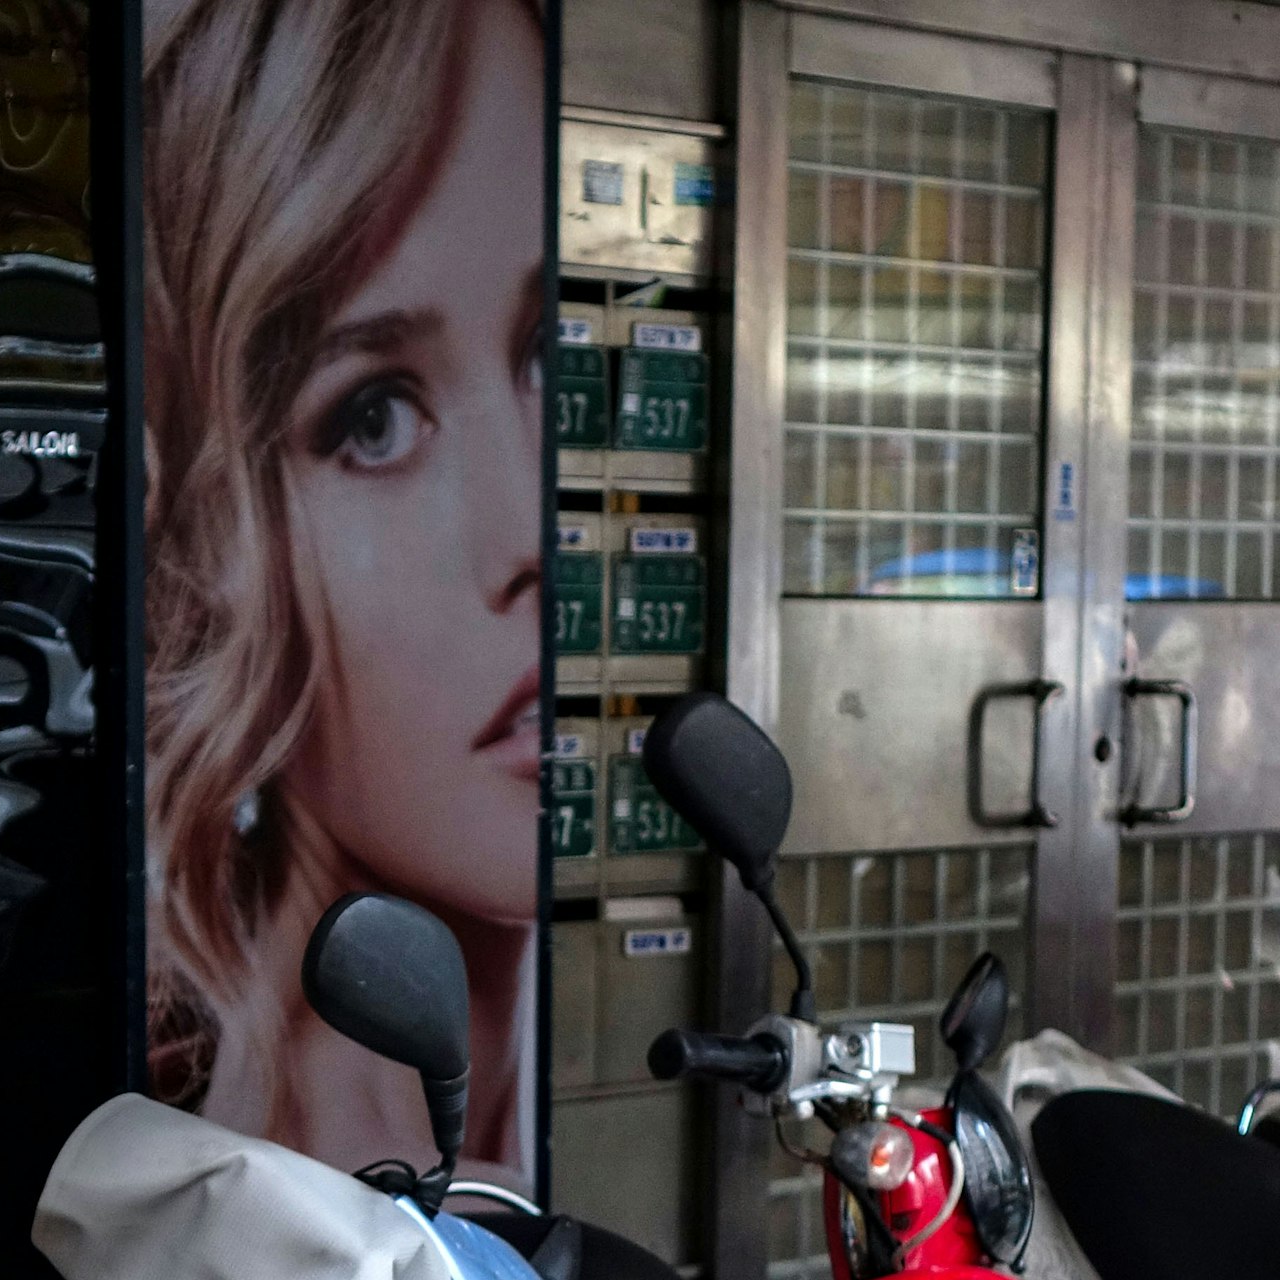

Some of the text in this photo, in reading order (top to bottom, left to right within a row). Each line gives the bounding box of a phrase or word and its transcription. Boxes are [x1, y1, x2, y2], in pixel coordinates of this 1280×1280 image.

[645, 397, 690, 437] 537
[0, 430, 80, 458] SALON
[640, 600, 686, 642] 537
